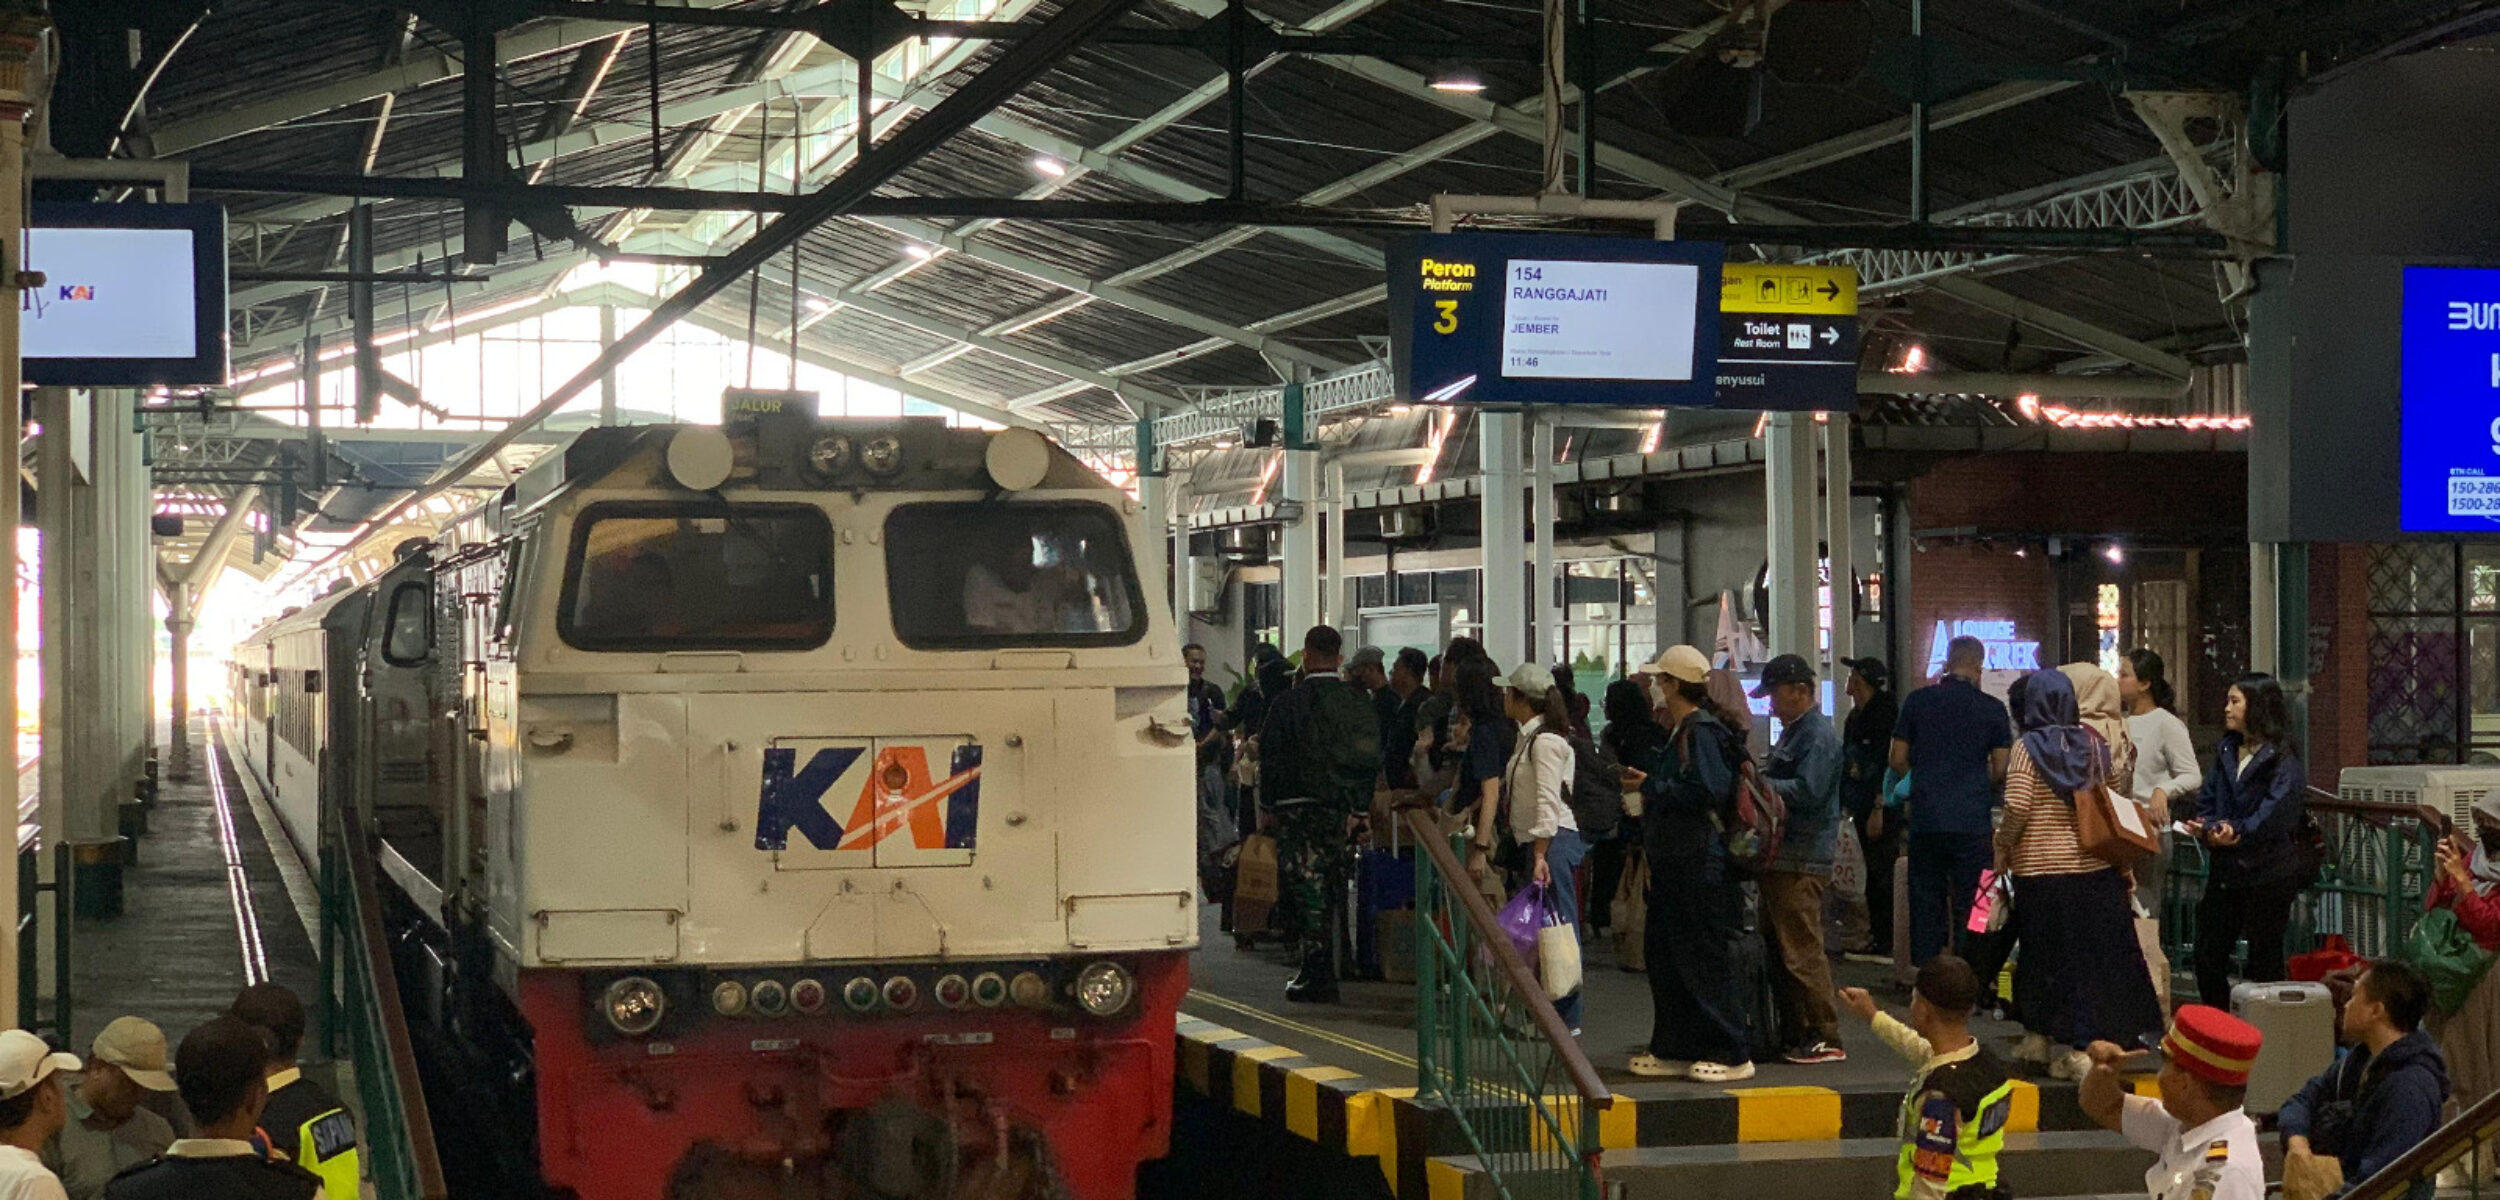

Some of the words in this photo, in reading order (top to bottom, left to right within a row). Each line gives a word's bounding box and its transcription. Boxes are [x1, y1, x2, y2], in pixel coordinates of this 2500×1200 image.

[1421, 259, 1476, 277] Peron
[1514, 267, 1542, 281] 154
[1423, 278, 1473, 291] Platform
[1513, 287, 1607, 301] RANGGAJATI
[1433, 300, 1458, 334] 3
[1510, 323, 1559, 334] JEMBER
[1744, 322, 1781, 335] Toilet
[1734, 338, 1754, 348] Rest
[1756, 339, 1781, 348] Room
[1510, 357, 1538, 367] 11:46
[732, 400, 782, 413] JALUR
[754, 745, 983, 851] KAI
